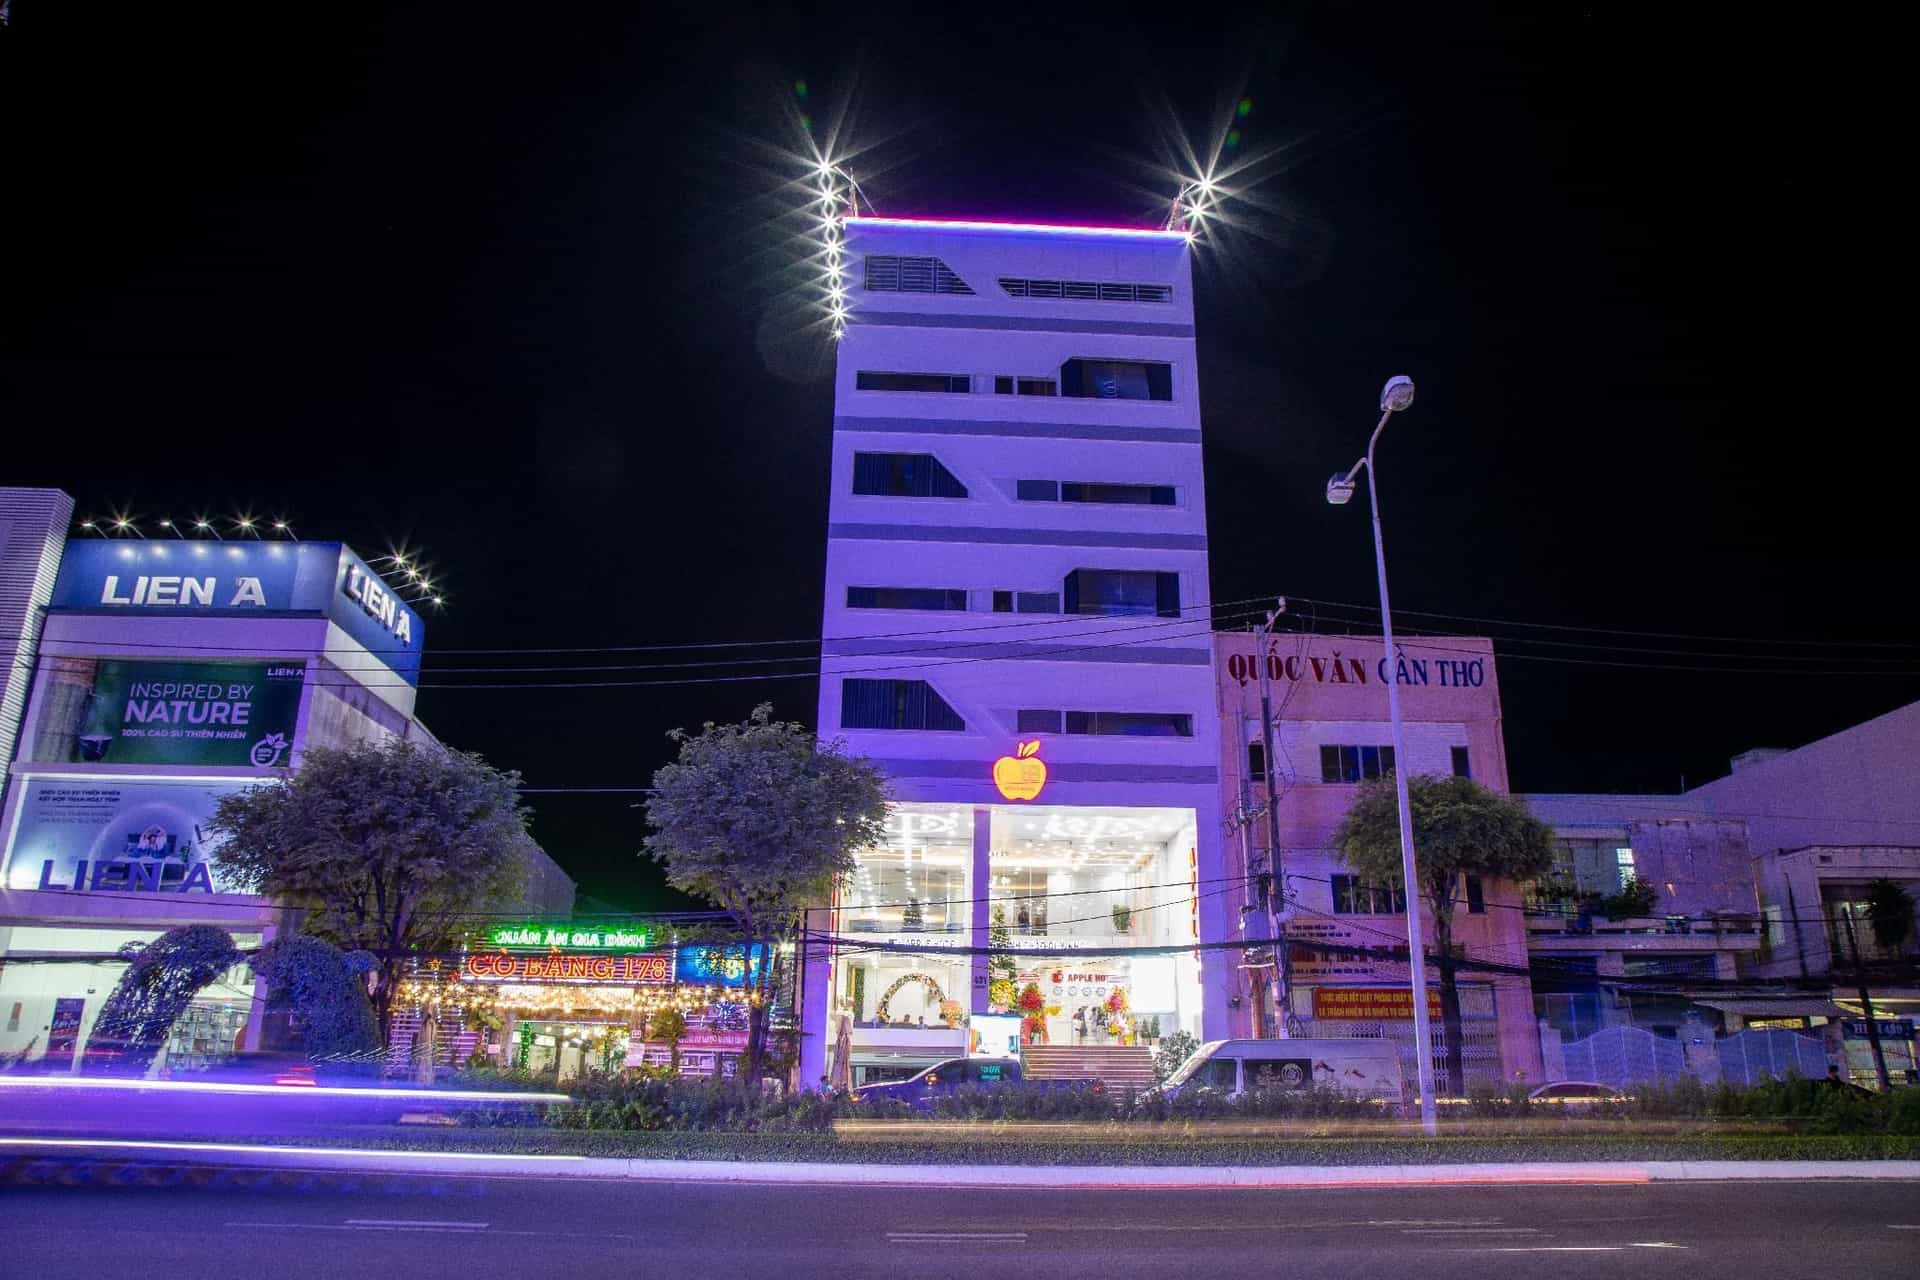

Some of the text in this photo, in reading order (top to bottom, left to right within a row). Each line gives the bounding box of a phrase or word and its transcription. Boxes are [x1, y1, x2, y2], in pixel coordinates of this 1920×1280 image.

[101, 575, 216, 605] LIEN
[346, 563, 396, 629] LIEN
[267, 668, 294, 676] LIEN
[1228, 640, 1301, 687] QUỐC
[1309, 650, 1367, 684] VĂN
[1435, 658, 1484, 687] THƠ
[130, 683, 254, 699] INSPIRED BY
[124, 700, 250, 725] NATURE
[147, 729, 169, 737] CAO
[171, 729, 184, 737] SU
[39, 860, 164, 892] LIEN
[495, 929, 541, 945] QUÁN
[572, 933, 600, 947] GIA
[623, 957, 666, 980] 178
[1068, 974, 1092, 982] APPLE
